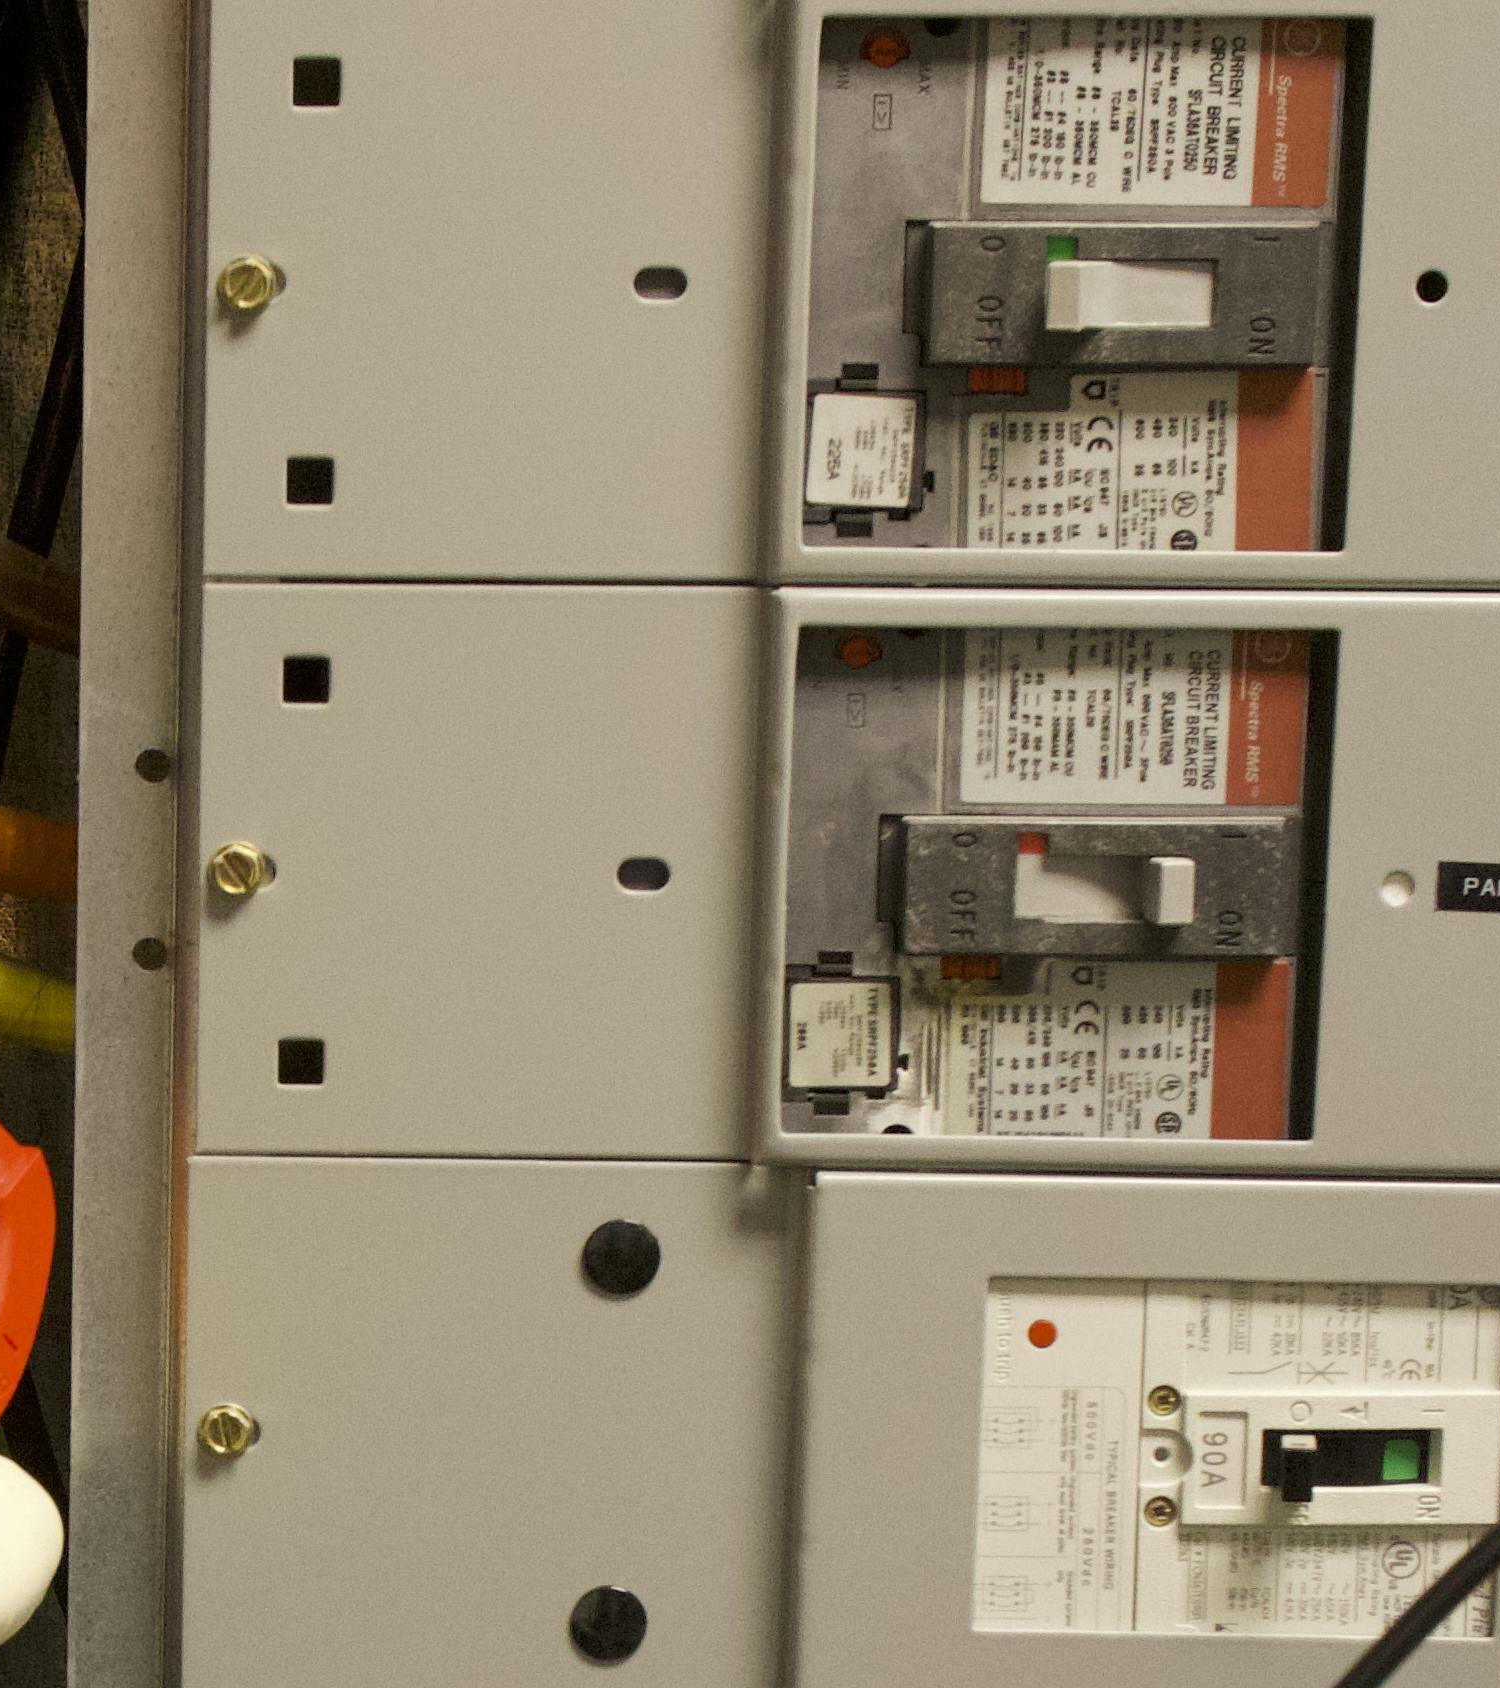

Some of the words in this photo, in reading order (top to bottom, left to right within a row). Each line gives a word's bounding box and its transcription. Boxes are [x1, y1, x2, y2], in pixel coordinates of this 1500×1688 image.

[1208, 36, 1227, 97] CIRCUIT
[1228, 36, 1247, 107] CURRENT
[1274, 75, 1292, 137] Spectra
[1203, 106, 1221, 175] BREAKER
[1223, 117, 1242, 180] LIMITING
[974, 295, 1004, 352] OFF
[1249, 317, 1276, 357] ON
[827, 439, 842, 480] 225A
[1187, 651, 1204, 711] CIRCUIT
[1204, 650, 1222, 722] CURRENT
[1246, 681, 1264, 740] Spectra
[1183, 716, 1200, 787] BREAKER
[1200, 727, 1217, 791] LIMITING
[950, 890, 976, 941] OFF
[1215, 910, 1243, 949] ON
[1105, 1440, 1119, 1485] TYPICAL
[1202, 1433, 1227, 1488] 90A
[1104, 1491, 1117, 1543] BREAKER
[1416, 1494, 1441, 1519] ON
[1103, 1548, 1115, 1591] WIRING
